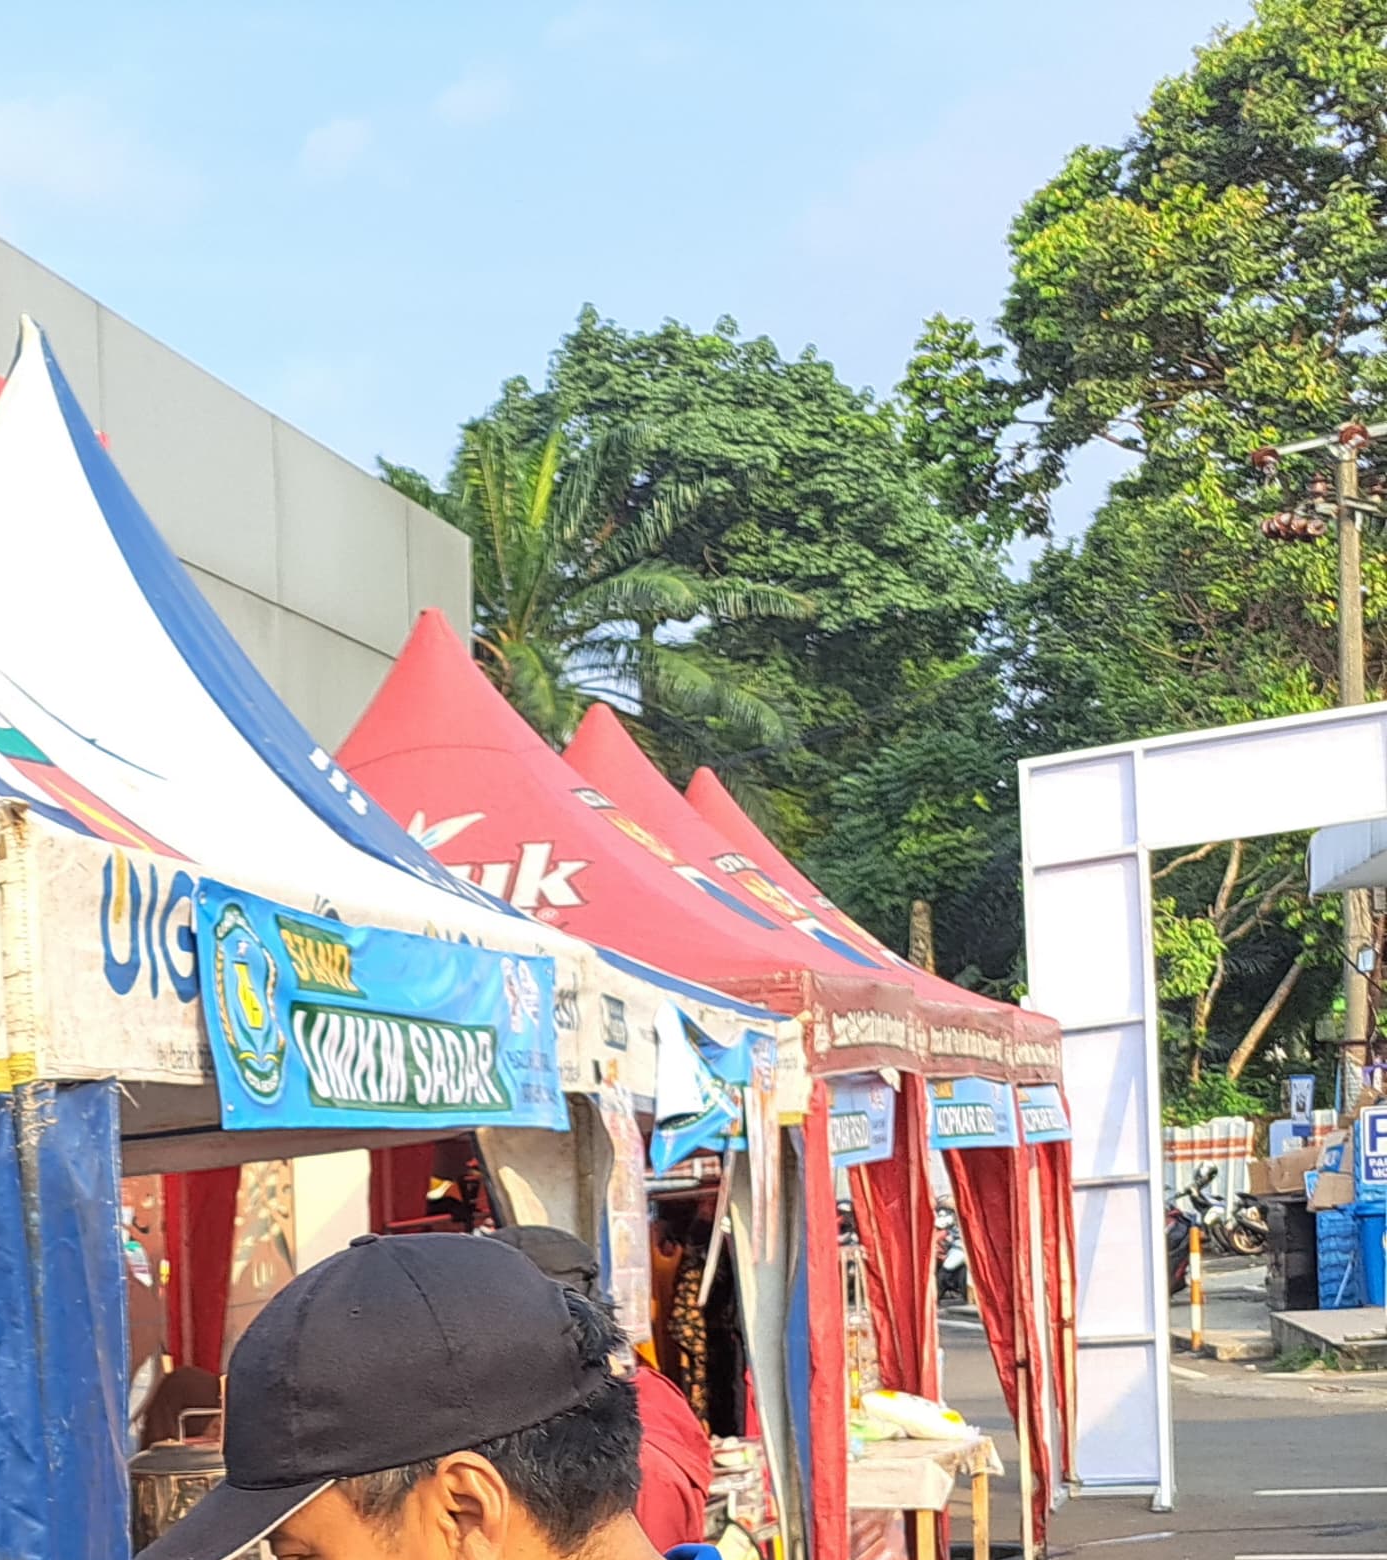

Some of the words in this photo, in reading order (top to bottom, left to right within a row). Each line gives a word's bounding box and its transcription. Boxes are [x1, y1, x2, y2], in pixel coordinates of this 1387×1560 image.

[280, 928, 360, 992] STAND
[293, 1009, 407, 1103] UMKM
[408, 1022, 505, 1106] SADAR
